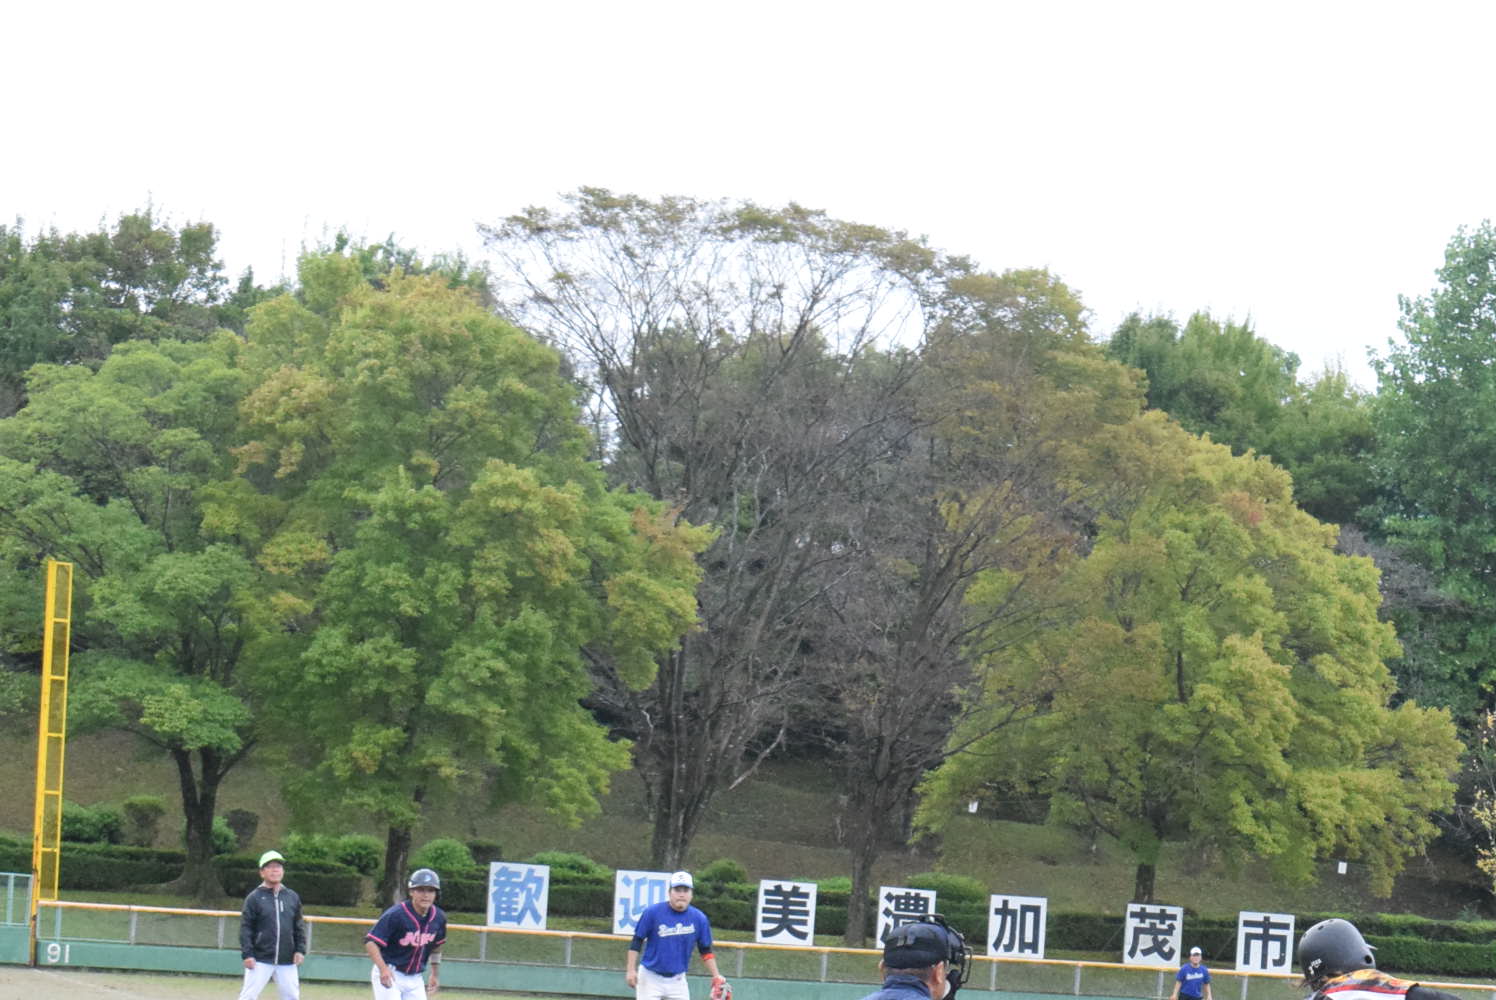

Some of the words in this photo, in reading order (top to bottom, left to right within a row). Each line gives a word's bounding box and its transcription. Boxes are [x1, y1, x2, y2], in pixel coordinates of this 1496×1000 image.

[491, 866, 545, 925] 歓
[47, 943, 70, 963] 91
[760, 884, 810, 941] 美
[992, 899, 1042, 955] 加
[1128, 906, 1178, 961] 茂
[1242, 915, 1291, 970] 市
